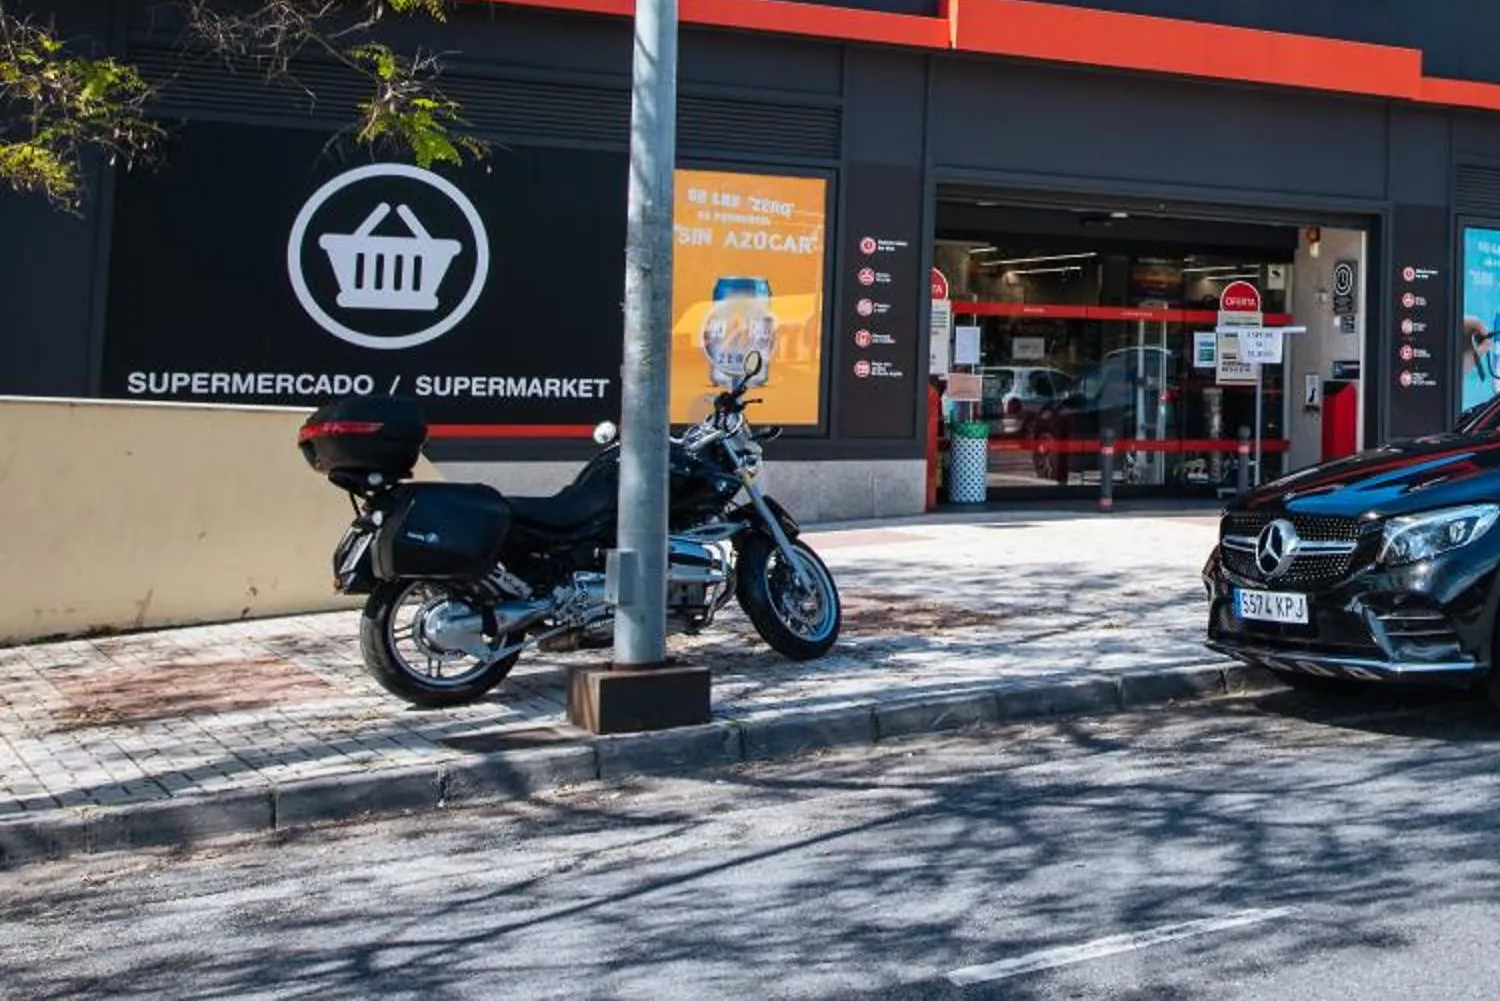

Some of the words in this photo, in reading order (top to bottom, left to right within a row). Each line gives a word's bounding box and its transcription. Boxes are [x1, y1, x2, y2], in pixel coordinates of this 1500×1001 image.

[127, 372, 374, 396] SUPERMERCADO
[390, 375, 400, 395] /
[415, 375, 610, 399] SUPERMARKET
